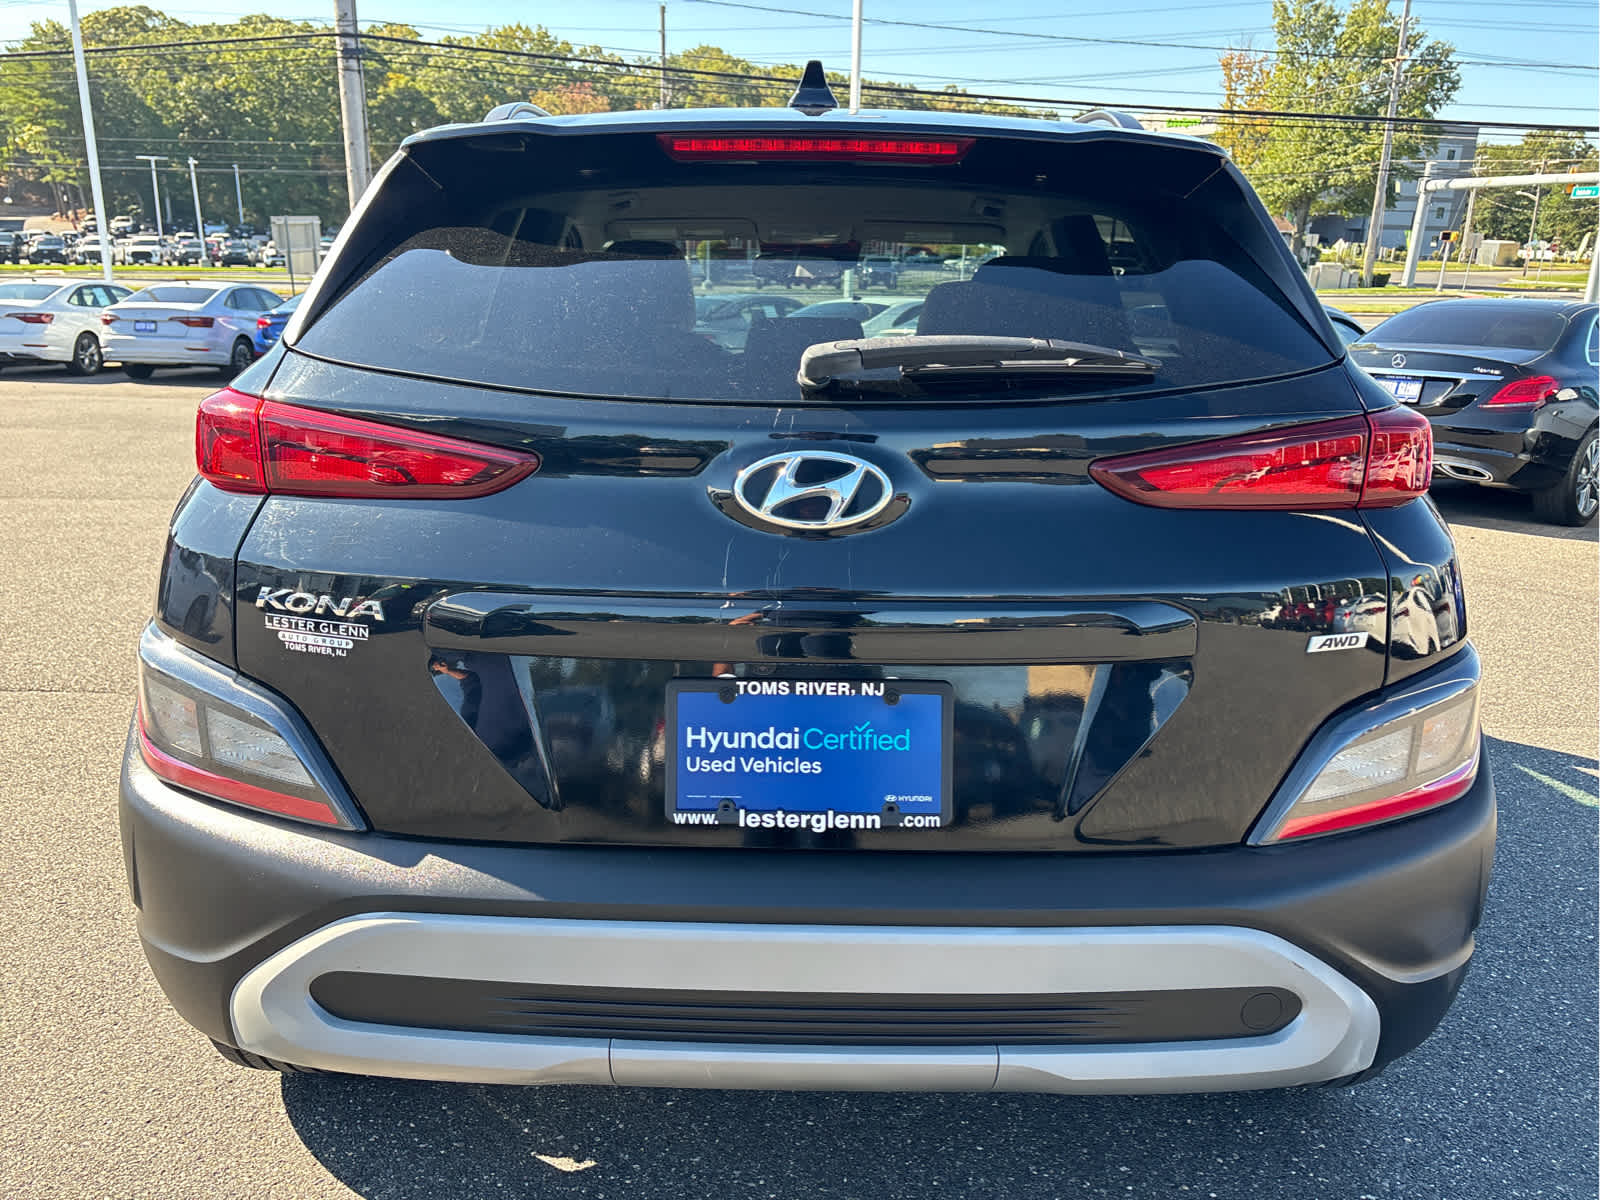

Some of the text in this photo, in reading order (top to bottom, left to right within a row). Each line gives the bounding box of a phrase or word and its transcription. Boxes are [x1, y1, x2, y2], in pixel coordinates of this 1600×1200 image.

[255, 586, 384, 621] KONA
[265, 615, 369, 638] LESTER GLENN
[281, 632, 351, 647] AUTO GROUP
[1317, 635, 1360, 649] AWD
[285, 641, 347, 657] TOMS RIVER, NJ
[736, 681, 885, 696] TOMS RIVER, NJ
[686, 721, 911, 752] Hyundai Certified
[686, 756, 823, 774] Used Vehicles
[898, 794, 933, 802] HYUNDAI
[673, 808, 941, 833] www. lesterglenn .com
